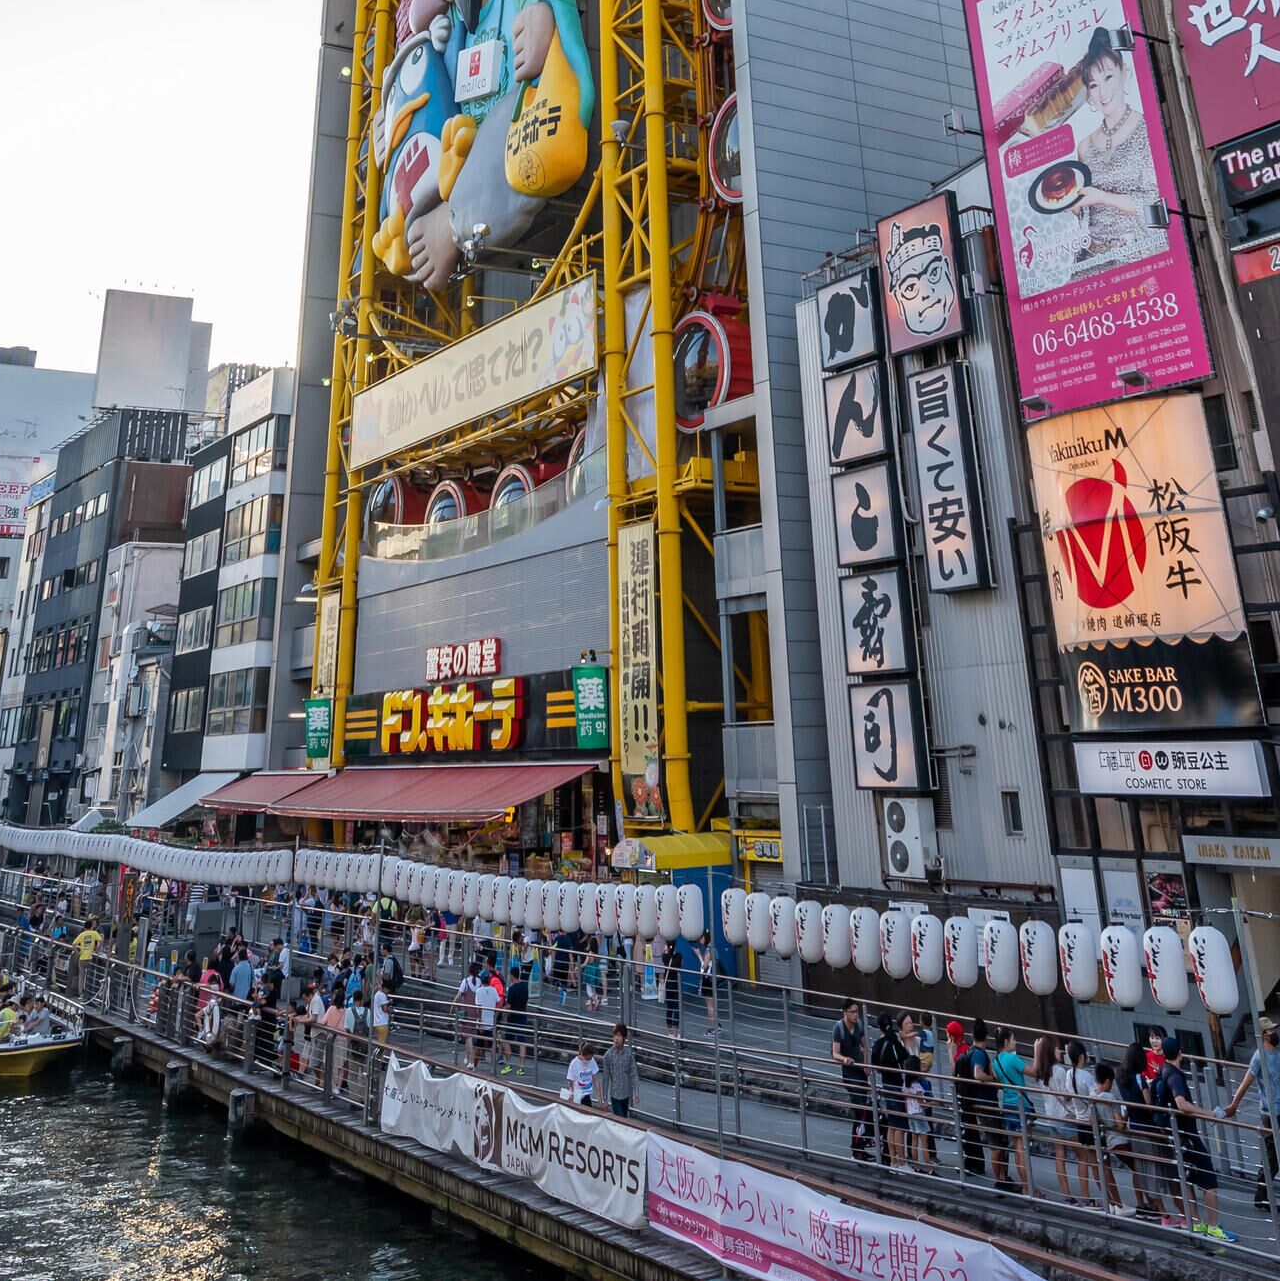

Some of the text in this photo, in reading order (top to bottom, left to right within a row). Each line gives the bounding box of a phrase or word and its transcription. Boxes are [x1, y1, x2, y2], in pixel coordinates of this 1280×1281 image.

[997, 7, 1108, 68] マダムブリュレ
[1008, 149, 1022, 170] 棒
[1221, 146, 1265, 176] The
[1032, 292, 1180, 356] 06-6468-4538
[1047, 427, 1128, 465] Yakiniku M
[915, 373, 969, 584] 旨くて安い
[1147, 477, 1202, 600] 松阪牛
[1112, 612, 1161, 630] 道頓堀店
[425, 638, 497, 681] 驚安の殿堂
[1108, 666, 1178, 684] SAKE BAR
[576, 676, 606, 711] 薬
[1111, 685, 1183, 713] M300
[578, 712, 606, 720] Medicine
[595, 721, 607, 736] 약
[1171, 751, 1229, 771] 豌豆公主
[1125, 777, 1207, 790] COSMETIC STORE
[1232, 845, 1271, 861] KAIKAN
[505, 1115, 640, 1195] MGM RESORTS
[506, 1153, 533, 1175] JAPAN
